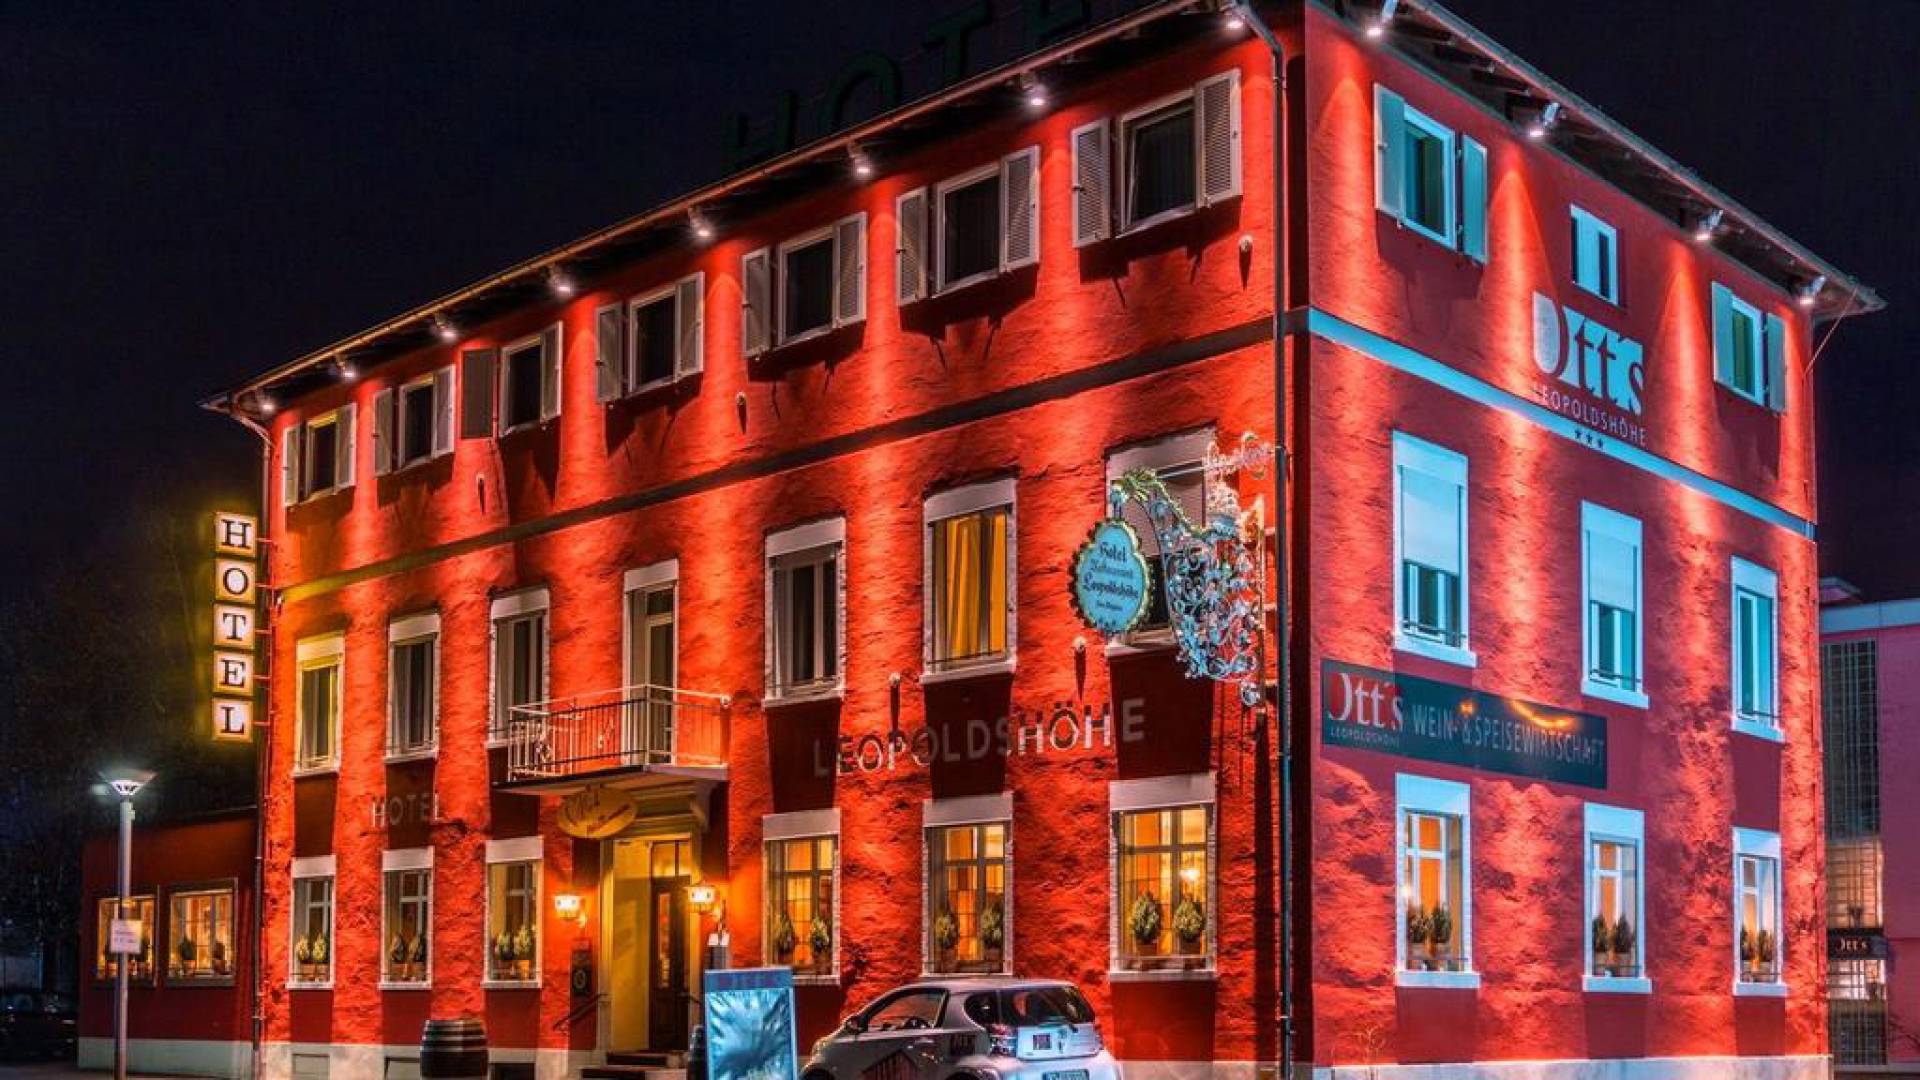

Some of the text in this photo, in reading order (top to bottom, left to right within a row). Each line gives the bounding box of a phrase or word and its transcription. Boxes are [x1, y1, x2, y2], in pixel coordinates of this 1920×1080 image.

[1532, 382, 1648, 446] LEOPOLDSHÖHE
[220, 518, 252, 734] HOTEL
[812, 697, 1146, 778] LEOPOLDSHÖHE
[1475, 716, 1605, 769] SPEISEWIRTSCHAFT
[371, 792, 442, 828] HOTEL
